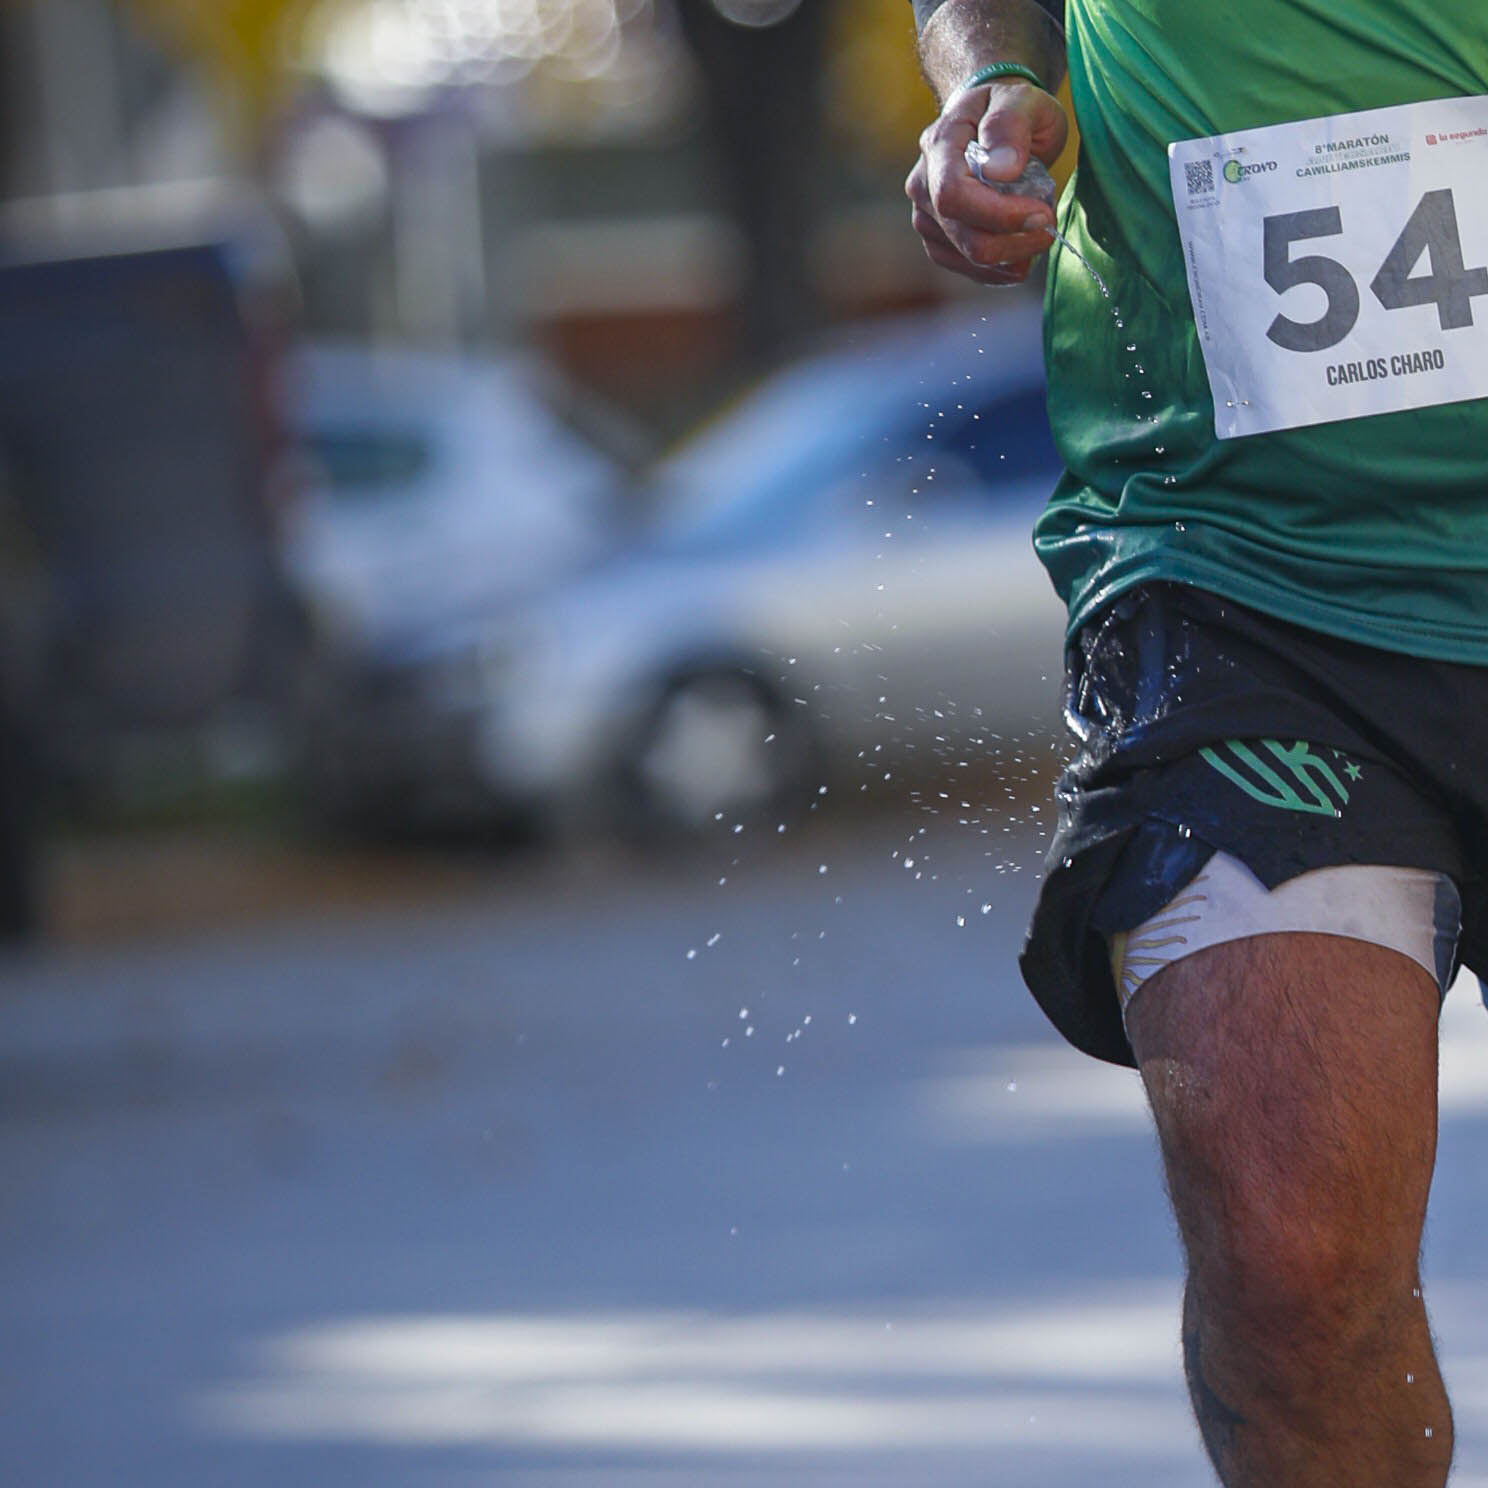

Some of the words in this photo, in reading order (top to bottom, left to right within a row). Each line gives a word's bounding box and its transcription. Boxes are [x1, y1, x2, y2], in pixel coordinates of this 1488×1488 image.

[1295, 151, 1411, 178] CAWILLIAMSKEMMIS
[1326, 357, 1388, 386] CARLOS
[1390, 348, 1445, 377] CHARO
